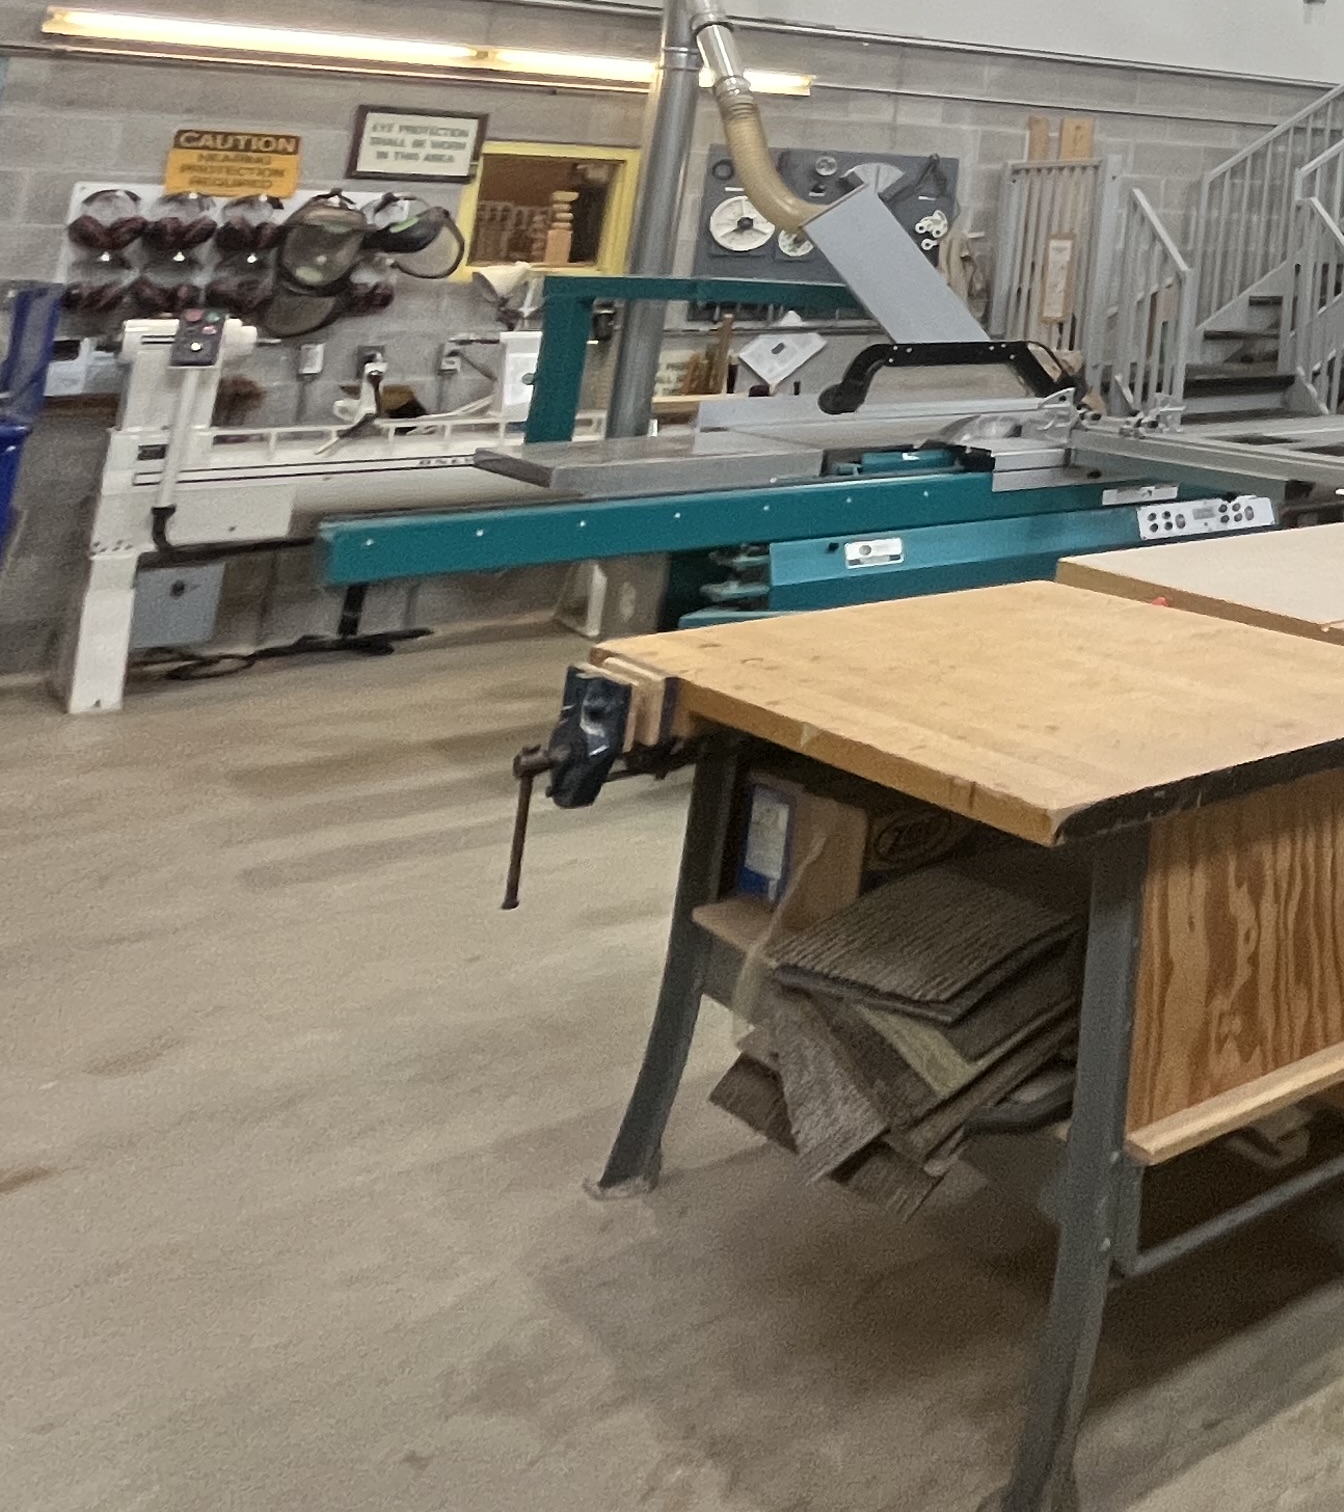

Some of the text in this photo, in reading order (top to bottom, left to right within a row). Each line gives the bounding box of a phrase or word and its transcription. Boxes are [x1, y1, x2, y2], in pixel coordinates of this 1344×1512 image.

[399, 125, 469, 138] PROTECTION
[180, 131, 296, 153] CAUTION
[195, 152, 272, 166] HEARING
[179, 163, 284, 178] PROTECTION
[189, 175, 273, 190] REQUIRED
